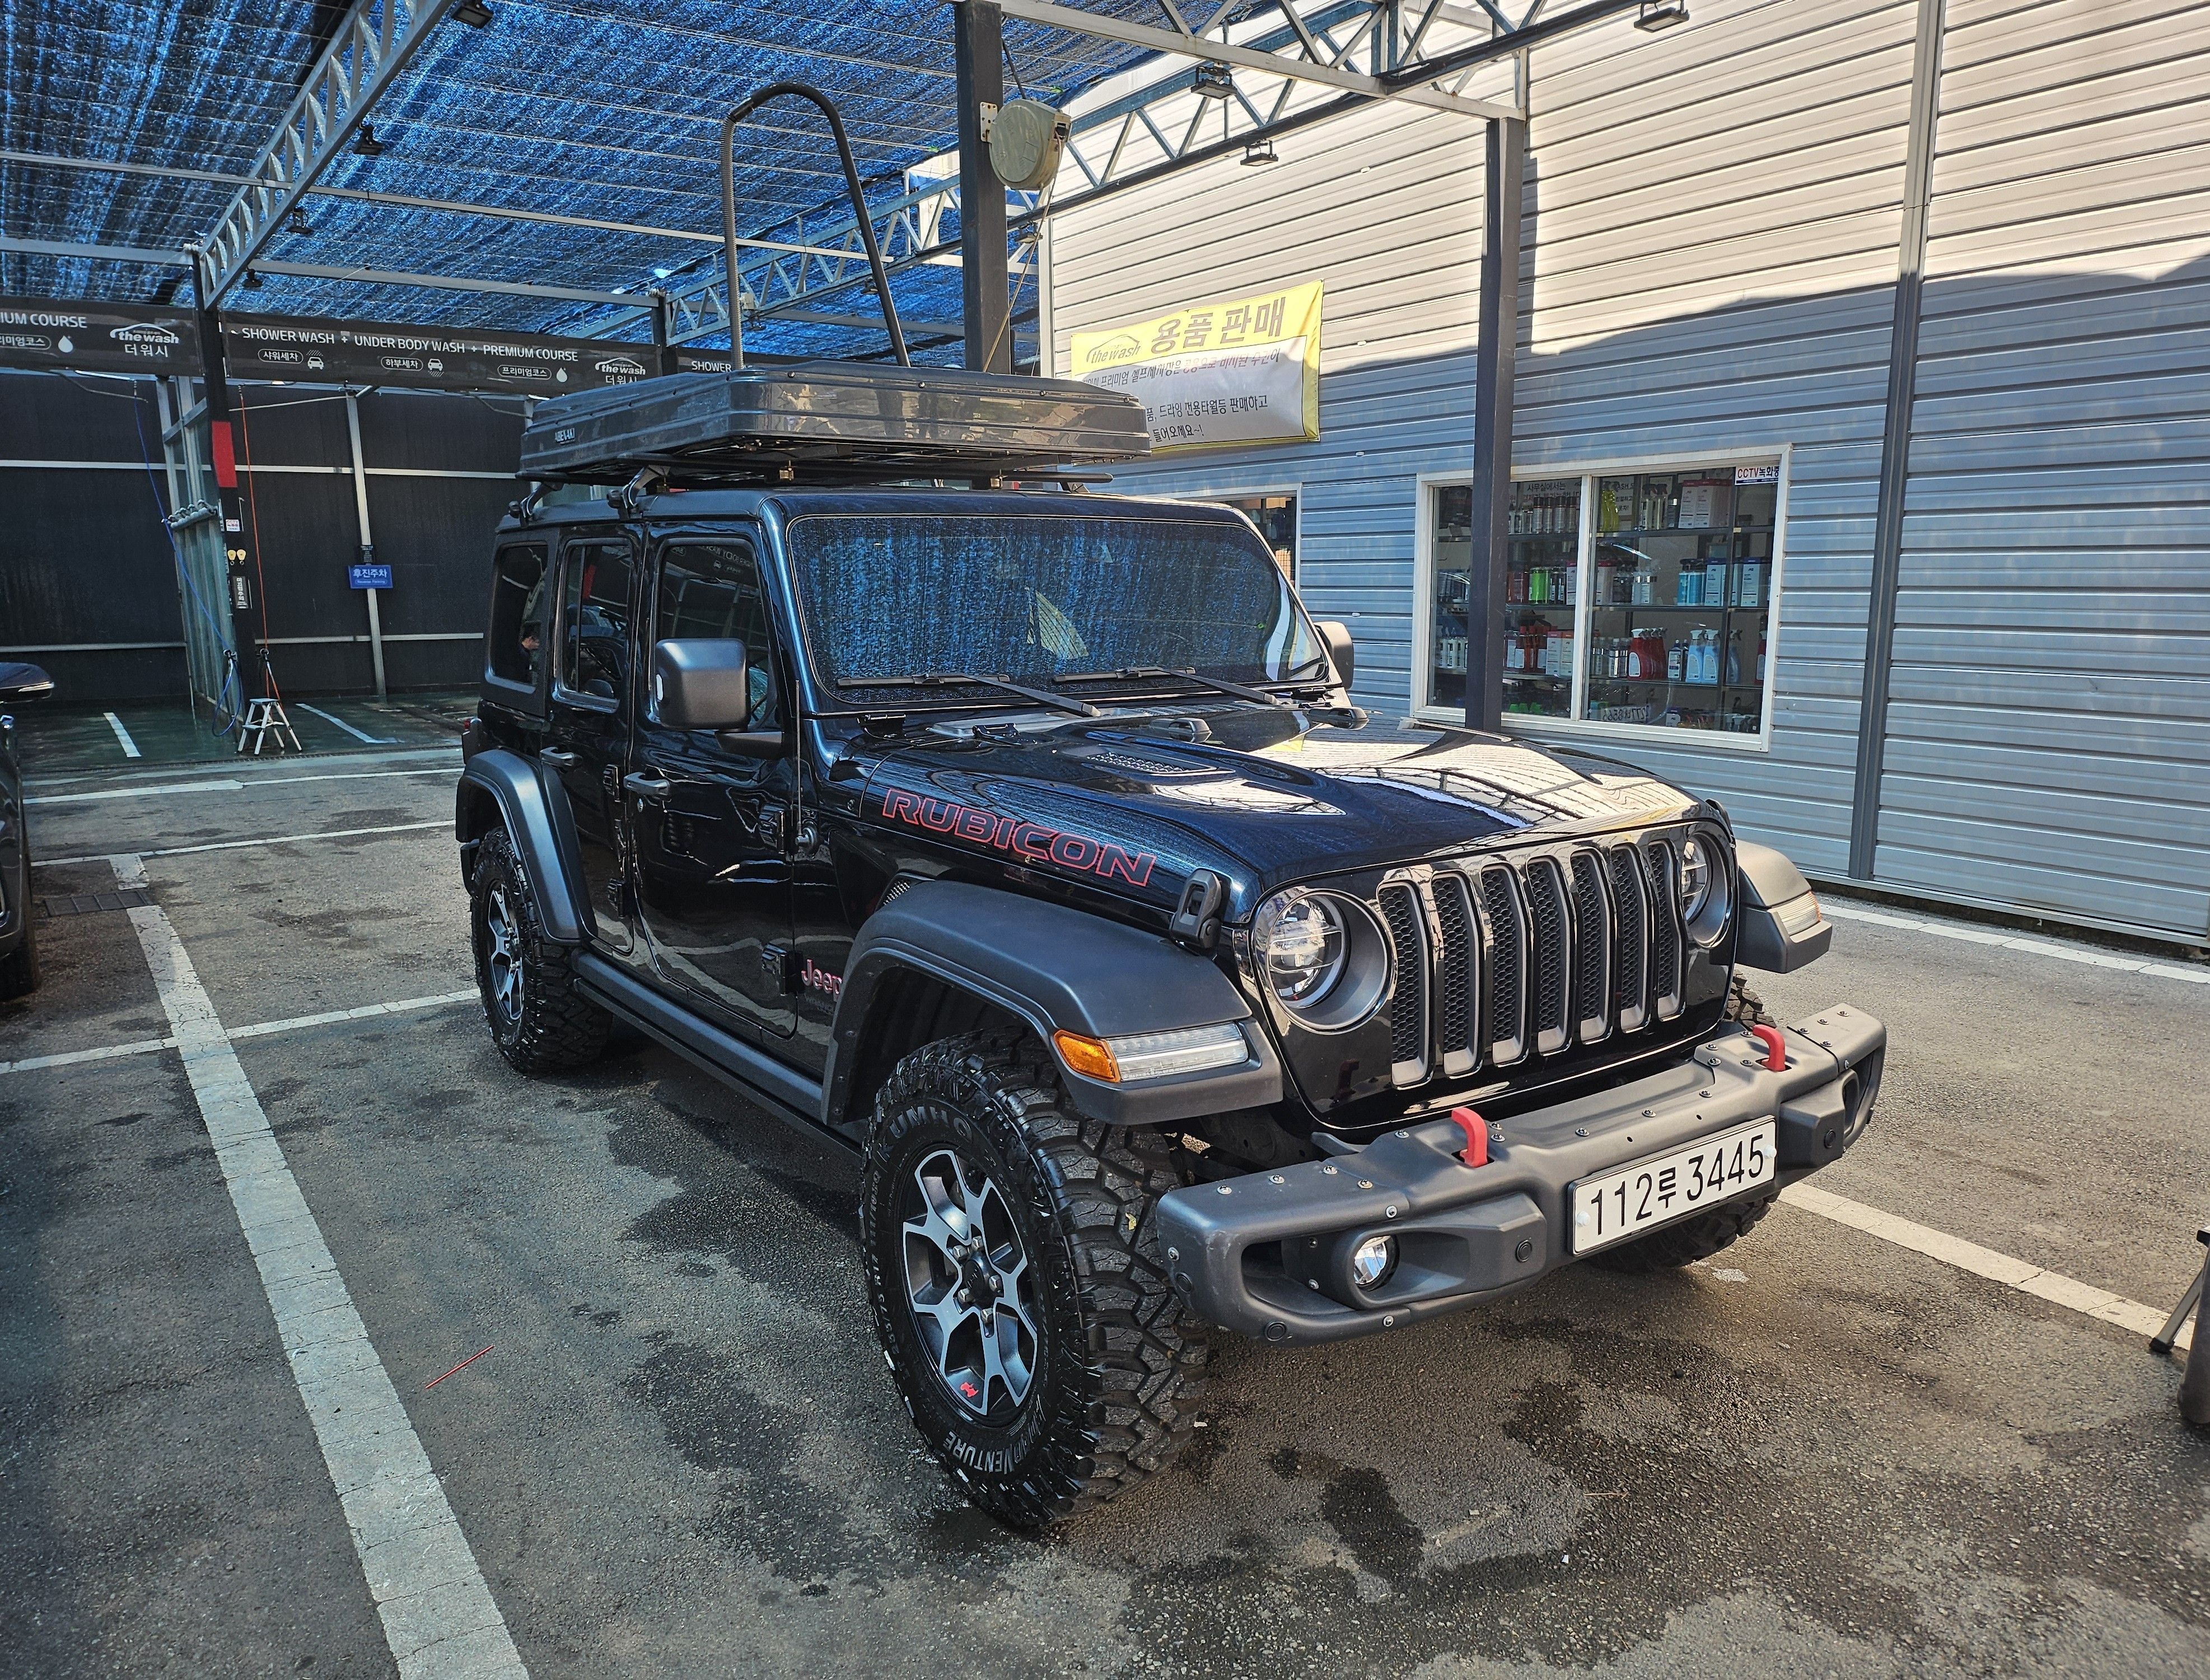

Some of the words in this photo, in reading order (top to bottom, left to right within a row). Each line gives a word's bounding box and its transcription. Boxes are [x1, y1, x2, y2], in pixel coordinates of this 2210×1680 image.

[30, 314, 88, 329] COURSE
[1151, 312, 1213, 354] 용품
[1220, 296, 1286, 344] 판매
[124, 343, 169, 358] 더워시
[241, 328, 297, 342] SHOWER
[298, 331, 335, 344] WASH
[354, 335, 395, 348] UNDER
[398, 338, 429, 351] BODY
[431, 340, 465, 353] WASH
[483, 344, 534, 358] PREMIUM
[535, 348, 578, 362] COURSE
[263, 350, 298, 362] 샤워세차
[385, 358, 419, 369] 하부세차
[502, 366, 548, 377] 프리미엄코스
[691, 360, 732, 372] SHOWER
[1100, 371, 1129, 388] 프리미엄
[1160, 402, 1183, 418] 드라잉
[1185, 399, 1227, 416] 전용타월등
[1230, 395, 1268, 413] 판매하고
[353, 568, 387, 578] 후진주차
[882, 788, 1157, 886] RUBICON
[801, 958, 843, 1003] Jeep
